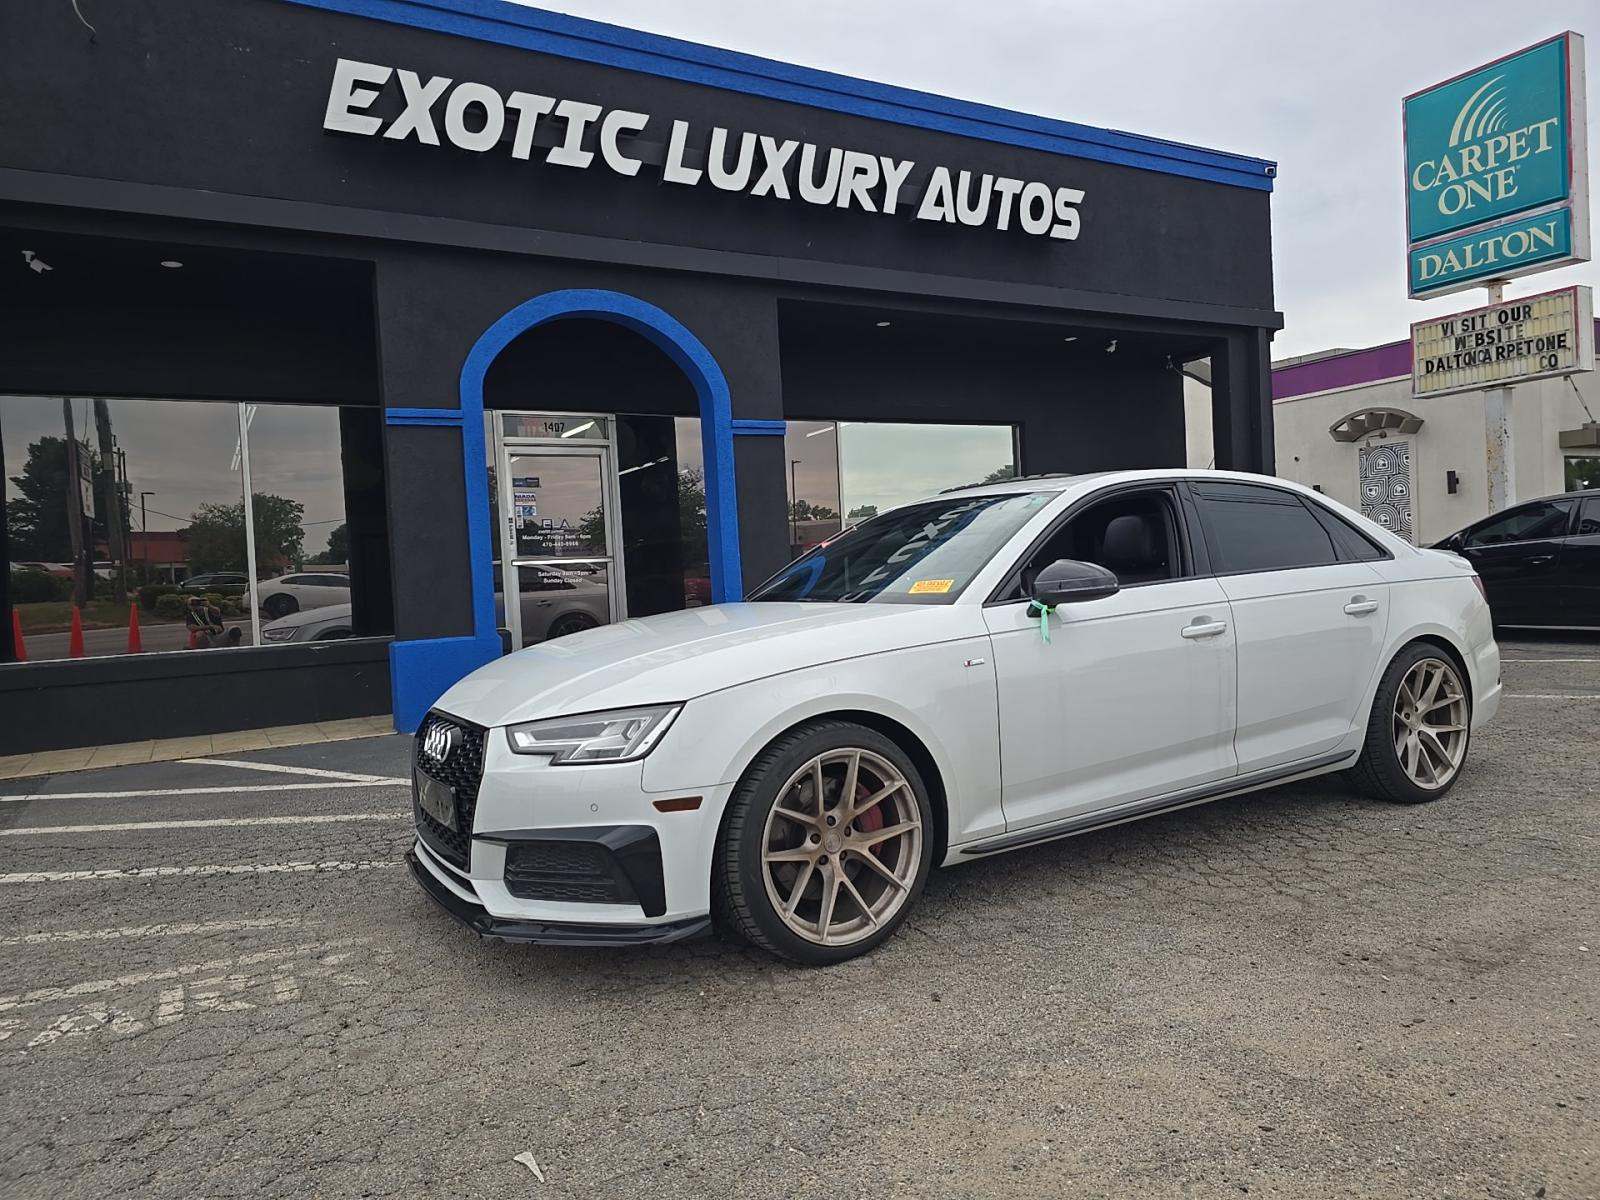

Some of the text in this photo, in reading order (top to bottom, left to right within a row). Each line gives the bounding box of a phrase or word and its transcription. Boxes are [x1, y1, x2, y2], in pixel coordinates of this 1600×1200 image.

[322, 57, 1085, 241] EXOTIC LUXURY AUTOS
[1412, 117, 1558, 191] CARPET
[1438, 166, 1519, 215] ONE
[1419, 221, 1557, 280] DALTON
[1455, 323, 1524, 350] WEBSITE
[1498, 304, 1532, 325] OUR
[543, 422, 565, 433] 1407
